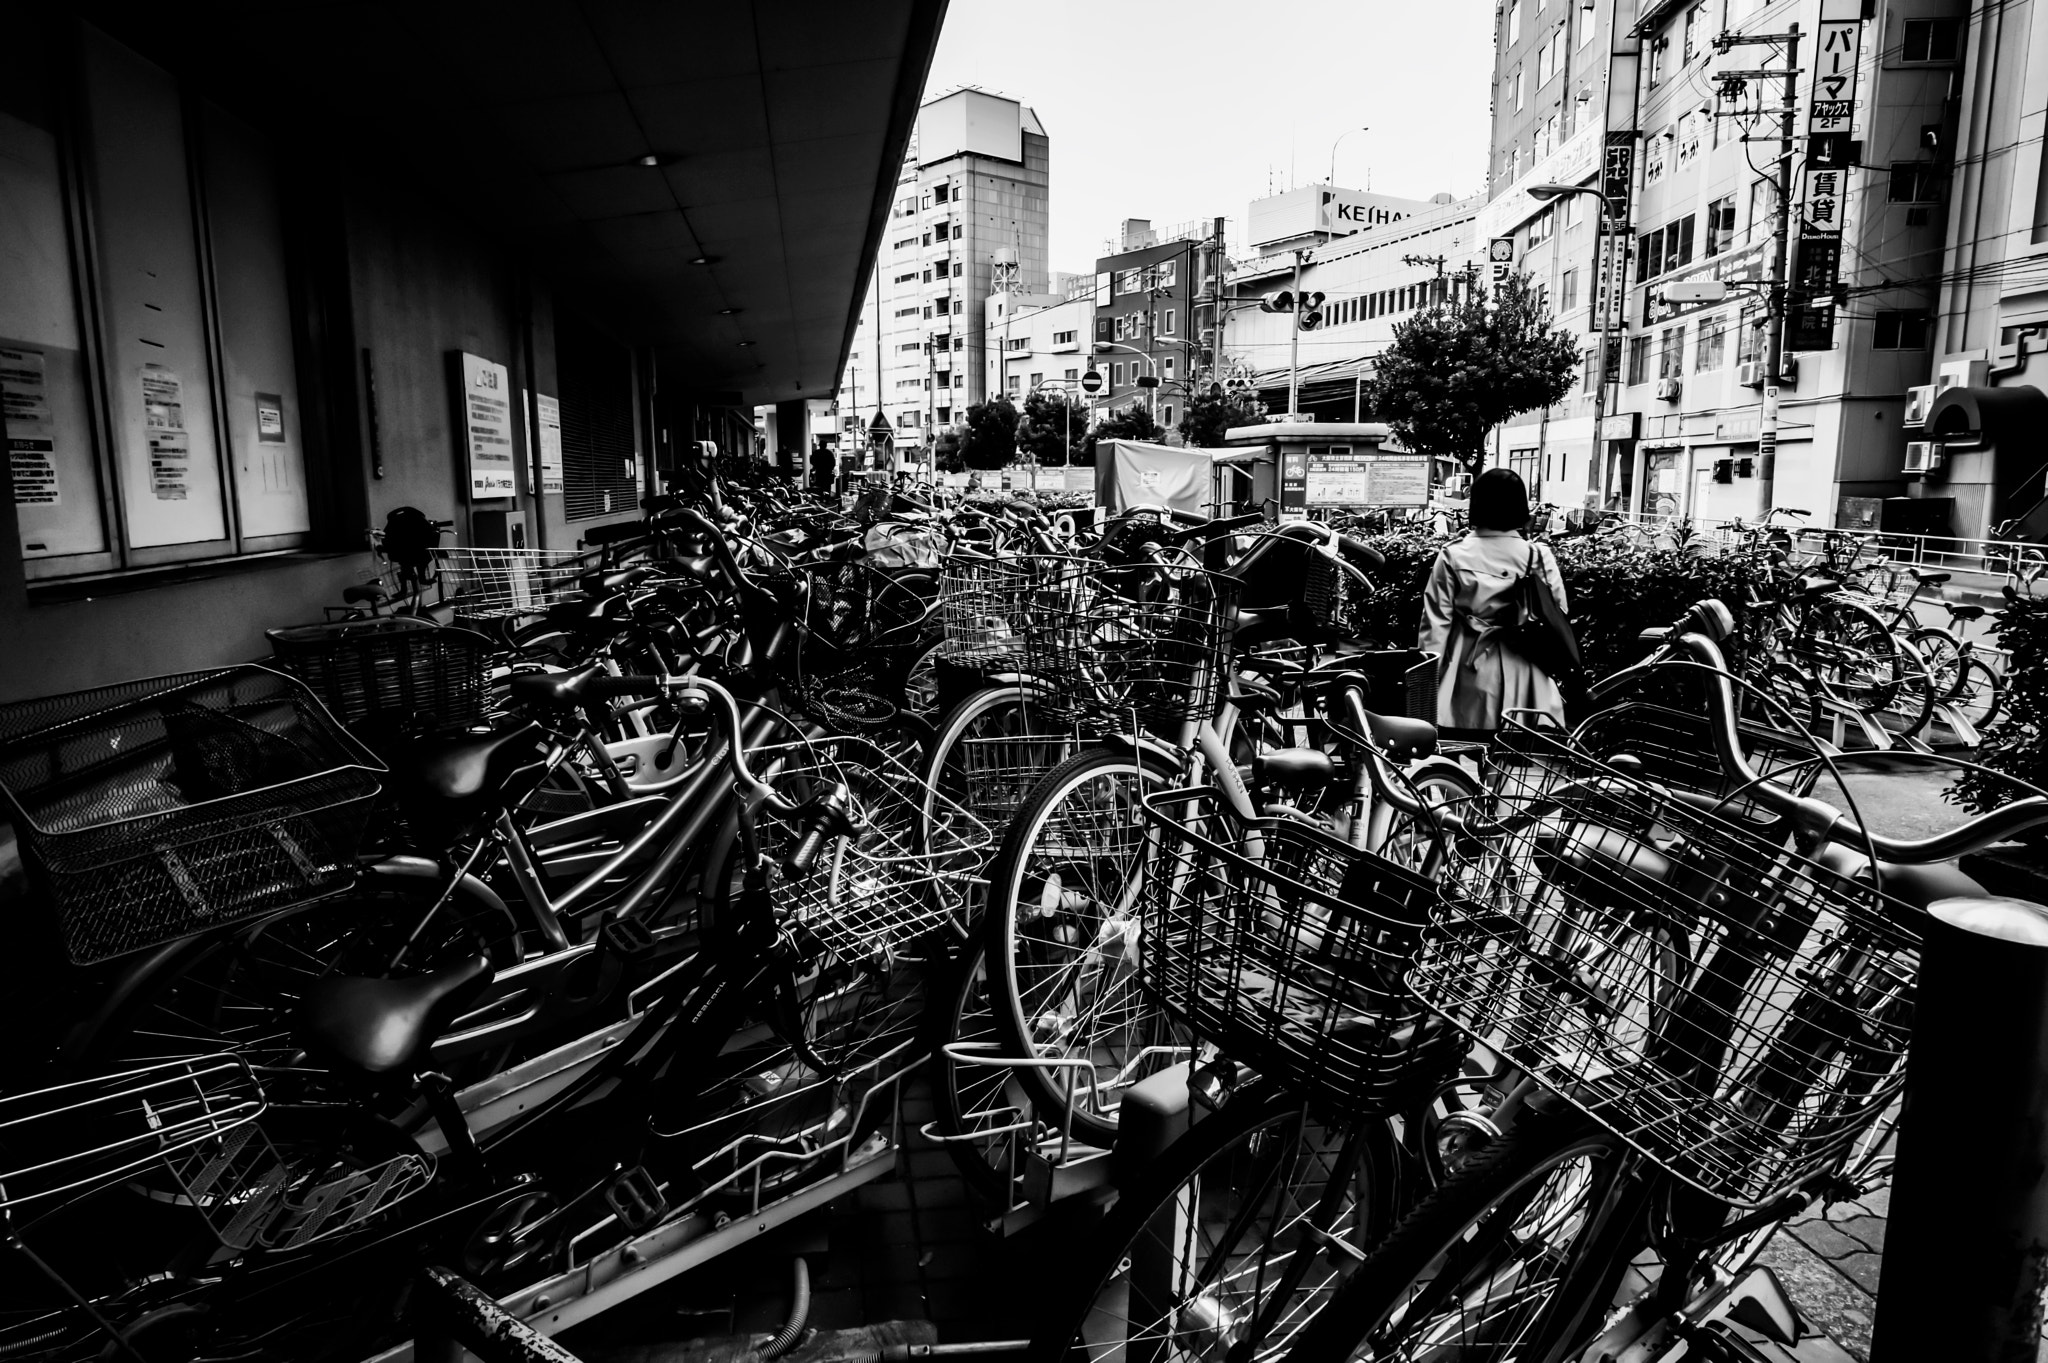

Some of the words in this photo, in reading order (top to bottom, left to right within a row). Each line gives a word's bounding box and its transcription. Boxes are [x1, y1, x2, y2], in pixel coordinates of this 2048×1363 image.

[1822, 27, 1853, 100] パーマ
[1814, 102, 1849, 116] アヤックス
[1820, 118, 1841, 128] 2F
[1811, 172, 1838, 223] 賃貸
[1338, 203, 1411, 225] KEIHA
